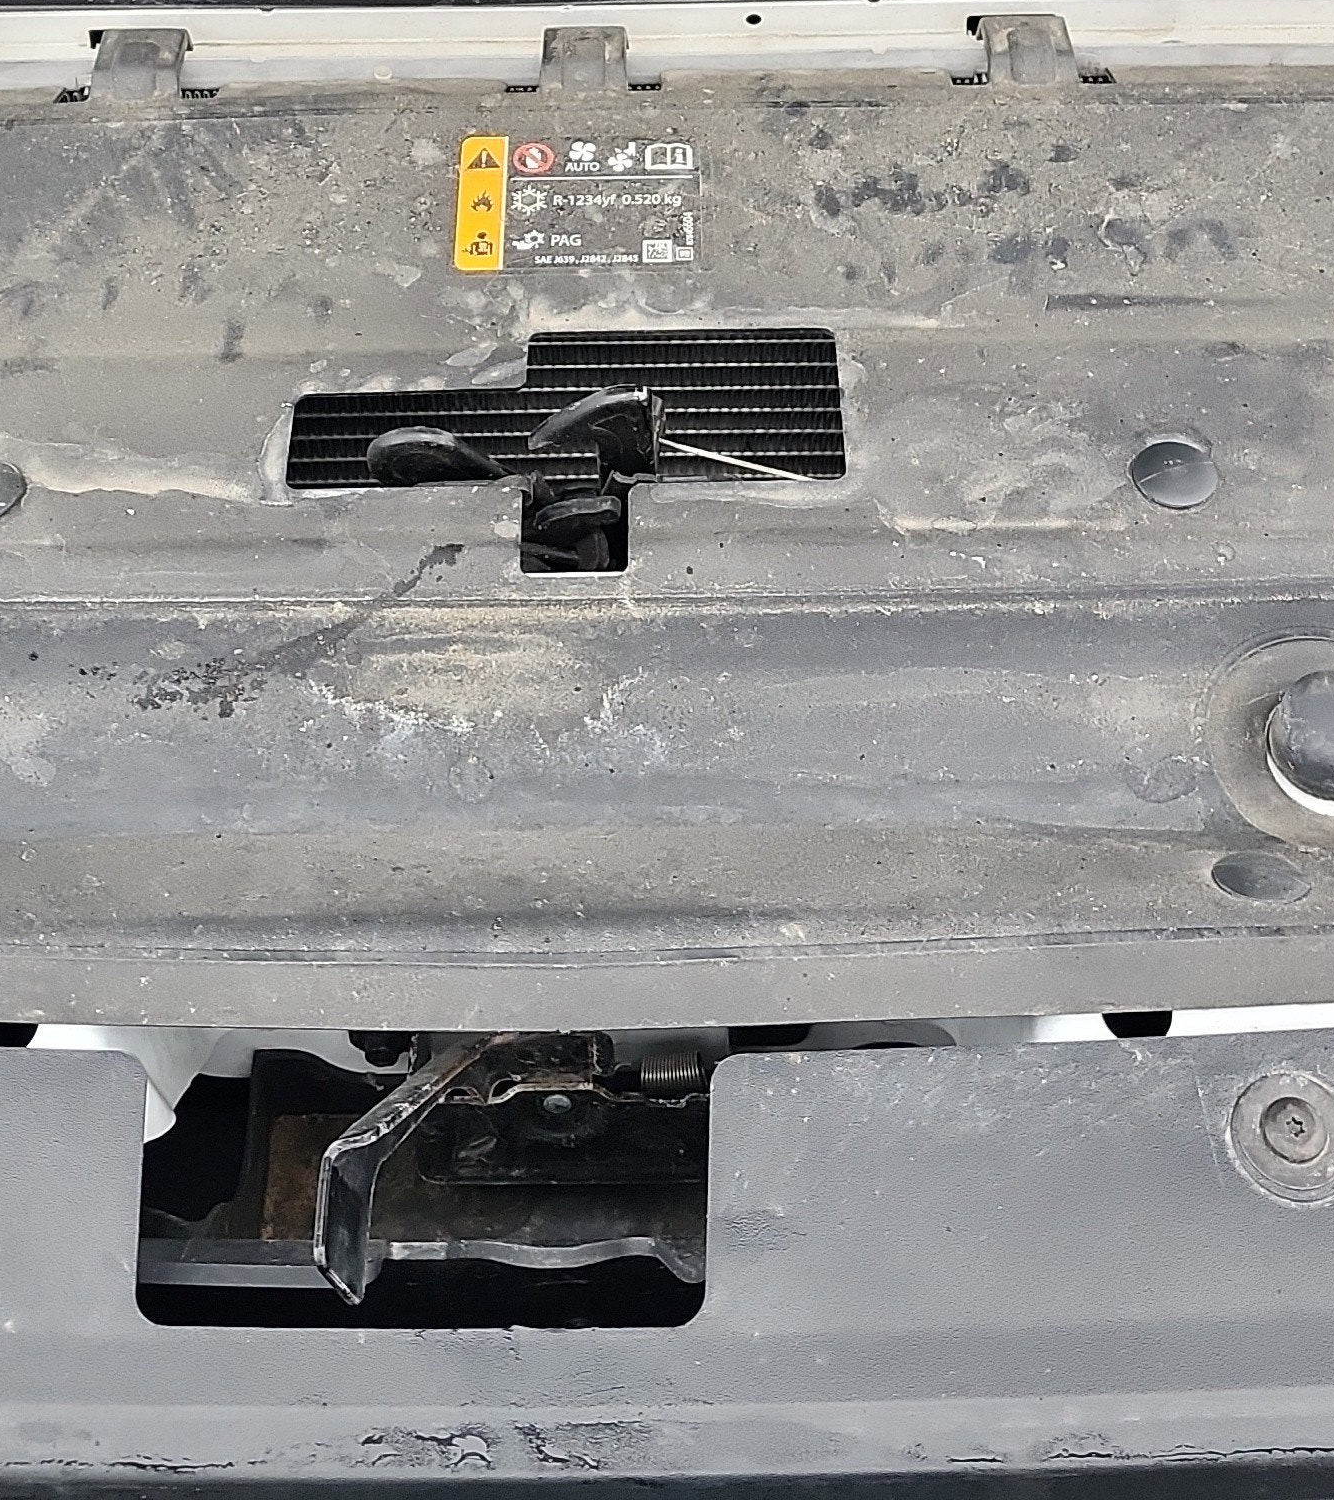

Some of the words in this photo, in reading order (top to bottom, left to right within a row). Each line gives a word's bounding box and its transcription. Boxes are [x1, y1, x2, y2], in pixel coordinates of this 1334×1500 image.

[565, 161, 601, 172] AUTO
[552, 193, 617, 208] R-1234yf
[621, 193, 661, 205] 0.520
[664, 193, 682, 209] kg
[550, 234, 582, 247] PAG
[534, 255, 552, 264] SAE
